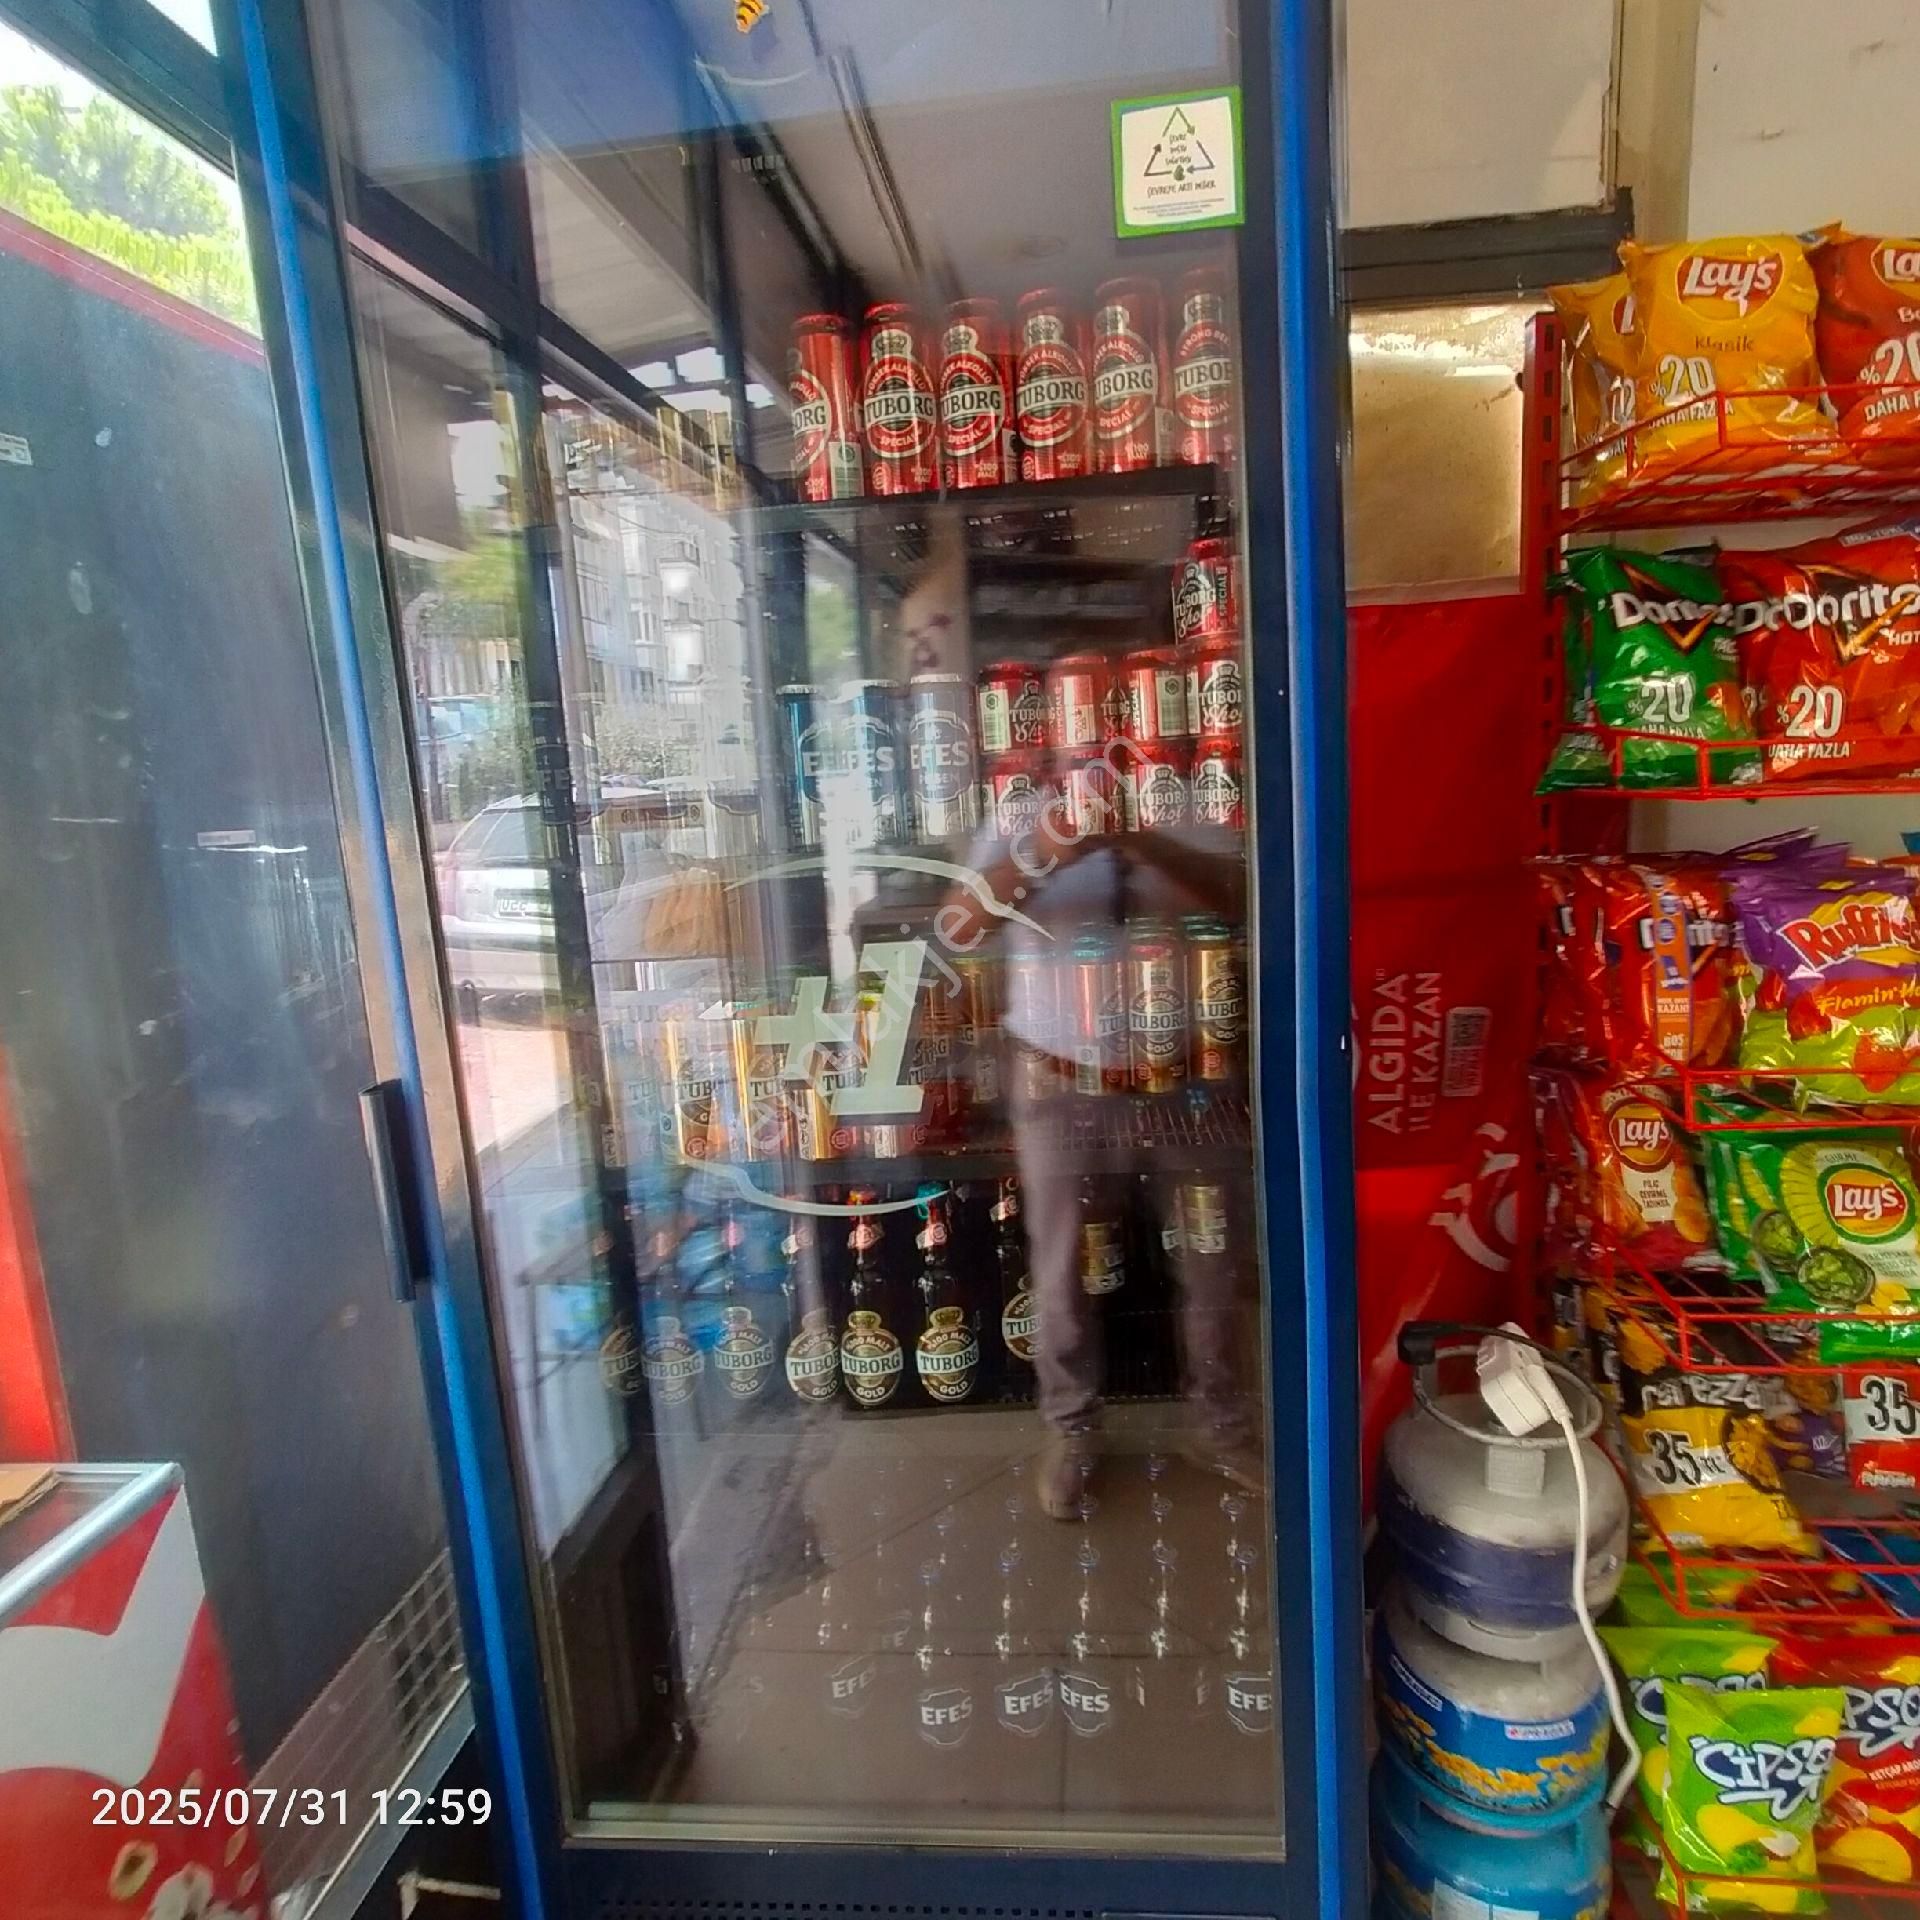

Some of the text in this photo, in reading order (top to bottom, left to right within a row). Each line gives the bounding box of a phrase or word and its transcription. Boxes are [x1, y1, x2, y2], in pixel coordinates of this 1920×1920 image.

[1683, 256, 1778, 318] Lay's
[866, 396, 934, 423] TUBORG
[942, 390, 1000, 420] UBORG
[1865, 393, 1911, 421] DAHA
[1783, 583, 1920, 630] Dorito
[1200, 690, 1242, 706] TUBO
[1777, 684, 1844, 739] %20
[910, 740, 970, 770] EFES
[1410, 972, 1442, 1083] KAZAN
[1146, 1041, 1174, 1053] GOLD
[1368, 973, 1409, 1135] ALGIDA
[1834, 1183, 1900, 1221] Lay's
[866, 1335, 890, 1351] MALT
[843, 1353, 901, 1374] TUBORG
[730, 1379, 759, 1392] GOLD
[856, 1386, 886, 1398] GOLD
[939, 1380, 969, 1395] GOLD
[1862, 1376, 1917, 1435] 35
[1646, 1430, 1702, 1486] 35
[921, 1696, 973, 1726] EFES
[1004, 1682, 1054, 1716] EFES
[1060, 1681, 1110, 1713] EFES
[1229, 1686, 1272, 1711] EFE
